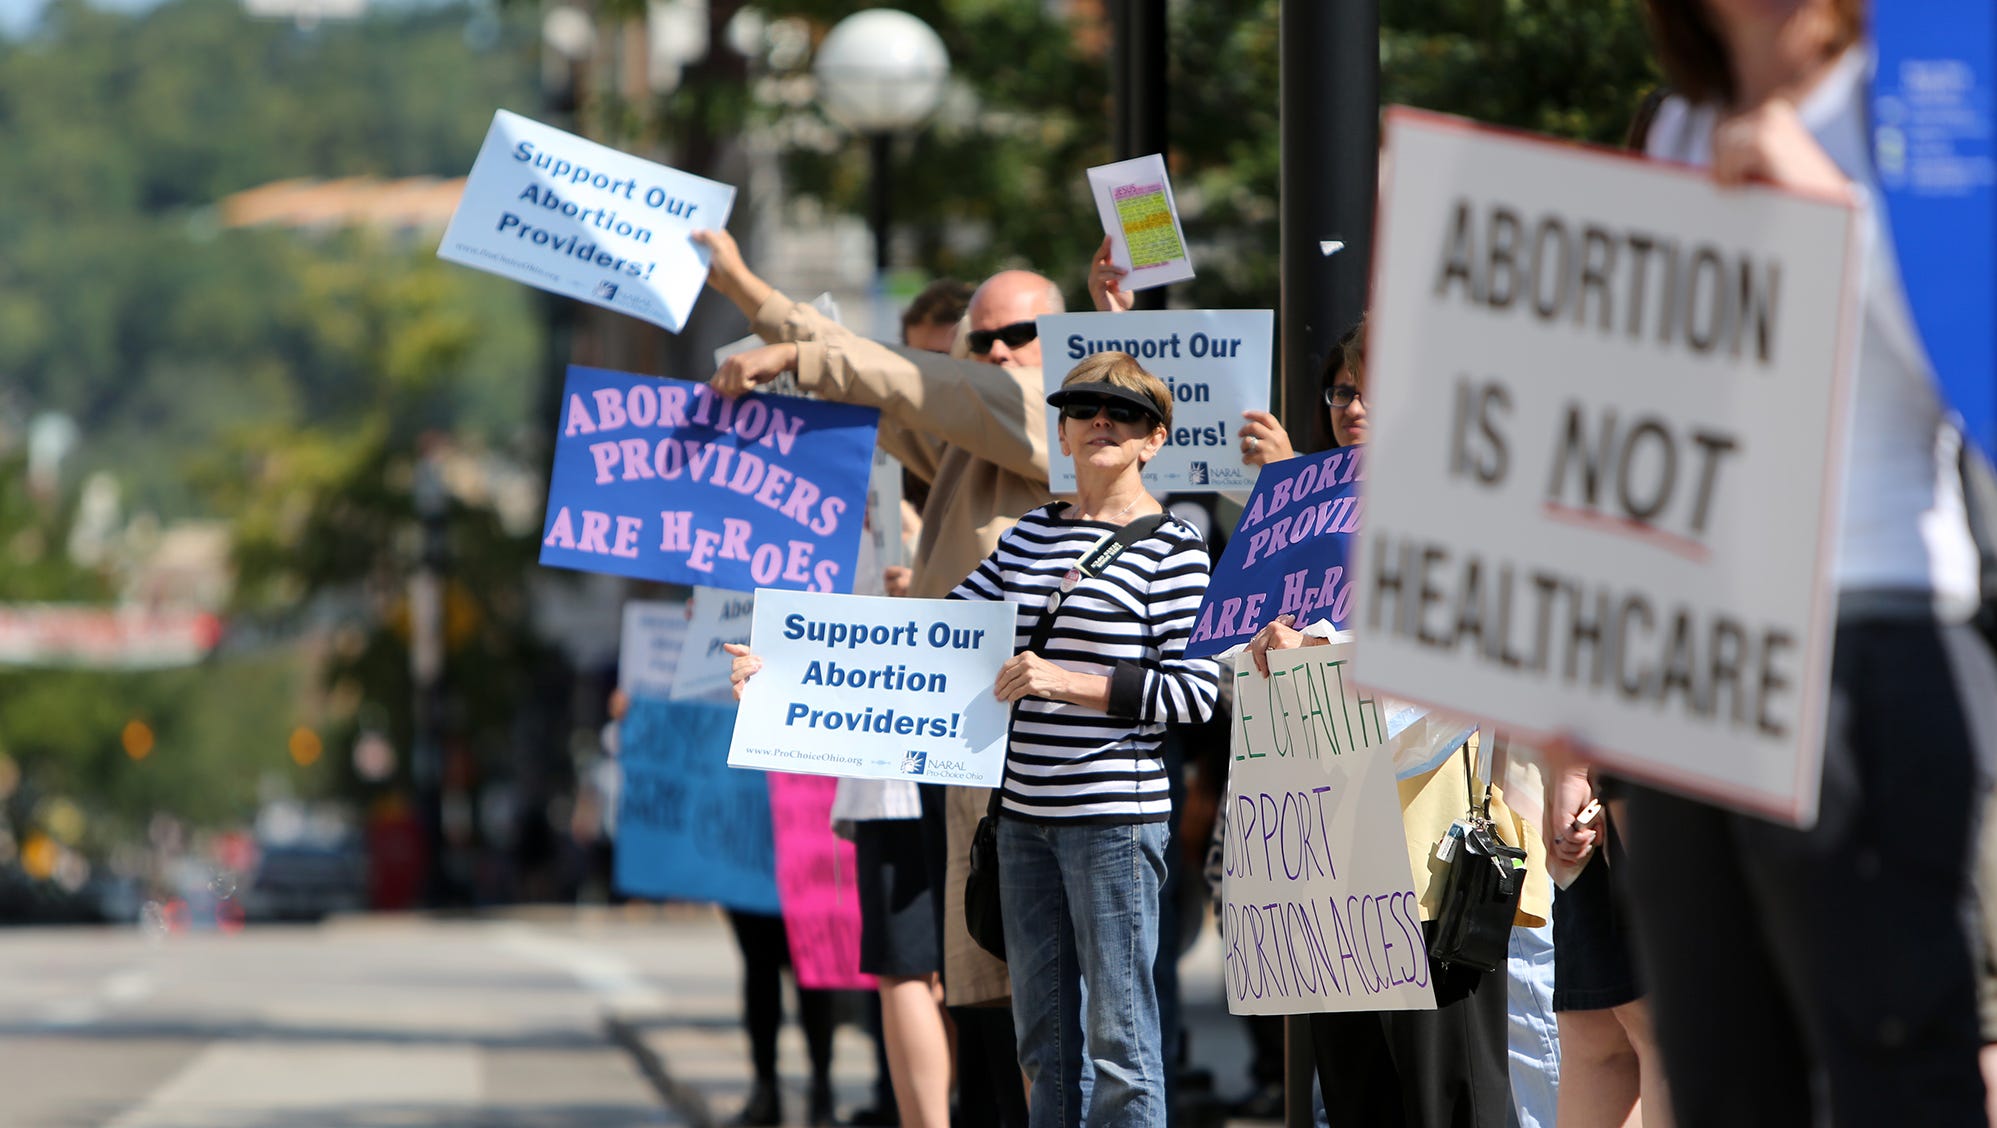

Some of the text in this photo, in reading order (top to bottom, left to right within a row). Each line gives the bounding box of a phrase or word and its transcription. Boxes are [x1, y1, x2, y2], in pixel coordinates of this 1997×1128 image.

[512, 141, 698, 220] Support Our
[519, 184, 652, 244] Abortion
[497, 212, 656, 280] Providers!
[1434, 198, 1782, 367] ABORTION
[1189, 331, 1242, 358] Our
[565, 383, 804, 456] ABORTION
[589, 438, 847, 537] PROVIDERS
[1447, 374, 1740, 537] IS NOT
[544, 506, 839, 593] ARE HEROES
[783, 613, 919, 649] Support
[927, 622, 985, 650] Our
[1189, 593, 1267, 644] ARE
[1365, 536, 1798, 739] HEALTHCARE
[801, 660, 948, 693] Abortion
[1292, 660, 1382, 760] FAITH
[785, 702, 960, 738] Providers!
[746, 747, 863, 766] www.ProChoiceOhio.org
[926, 769, 984, 781] Pro-Choice Ohio
[928, 759, 967, 771] NARAL
[1329, 891, 1428, 996] ACCESS
